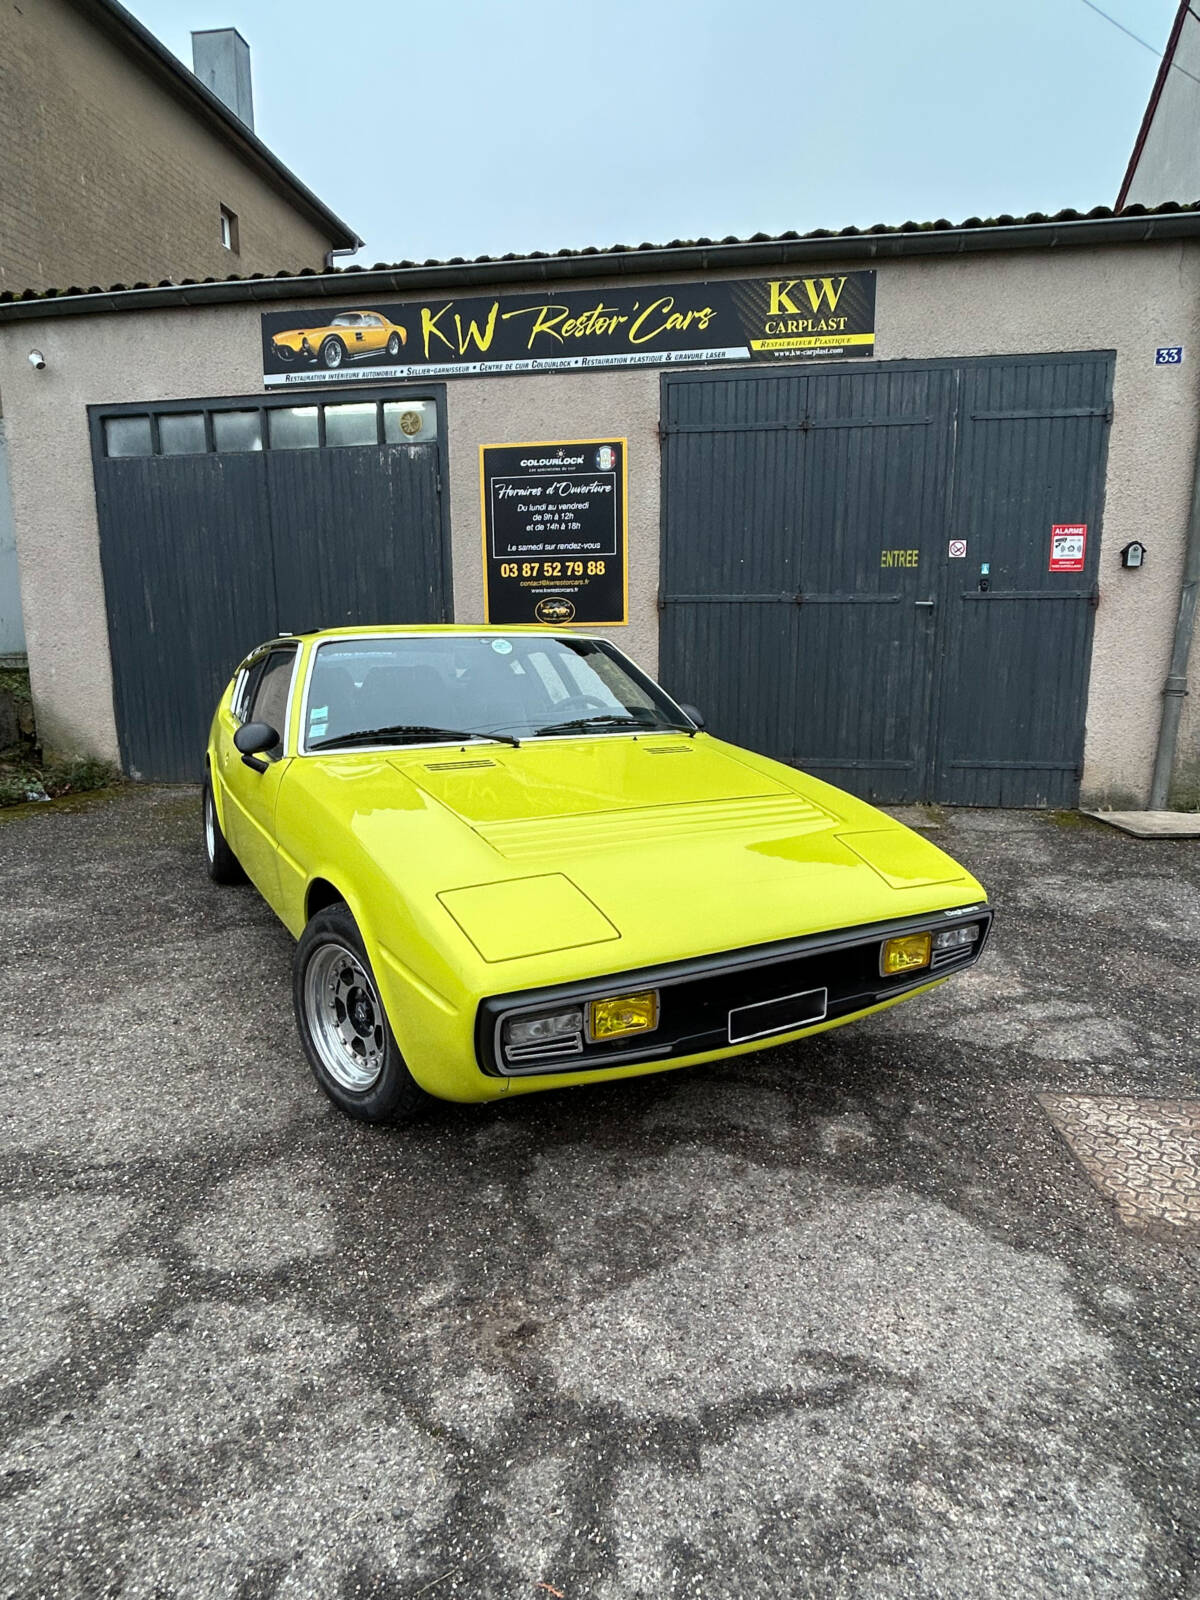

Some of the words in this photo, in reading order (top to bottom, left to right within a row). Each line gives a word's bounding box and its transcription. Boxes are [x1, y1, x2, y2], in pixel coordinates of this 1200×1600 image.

[767, 276, 848, 315] KW
[421, 302, 498, 359] KW
[765, 317, 847, 334] CARPLAST
[774, 348, 844, 357] www.kw-carplast.com
[1159, 349, 1178, 362] 33
[362, 370, 397, 378] AUTOMOBILE
[480, 363, 502, 371] CENTRE
[582, 356, 627, 366] RESTAURATION
[630, 354, 663, 363] PLASTIQUE
[666, 352, 672, 360] &
[675, 352, 704, 361] GRAVURE
[706, 351, 726, 359] LASER
[520, 457, 584, 466] COLOURLOCK
[495, 483, 542, 499] Horaires
[546, 481, 612, 496] d'Ouverture
[517, 504, 528, 512] Du
[529, 503, 547, 511] lundi
[559, 501, 589, 510] vendredi
[532, 513, 542, 521] de
[543, 513, 553, 521] 9h
[561, 512, 574, 520] 12h
[535, 523, 544, 531] de
[561, 522, 566, 530] à
[568, 522, 581, 530] 18h
[508, 543, 516, 552] Le
[518, 543, 543, 551] samedi
[557, 542, 601, 550] rendez-vous
[881, 550, 919, 567] ENTREE
[501, 563, 518, 577] 03
[522, 563, 539, 577] 87
[543, 562, 561, 576] 52
[565, 561, 583, 575] 79
[587, 561, 605, 575] 88
